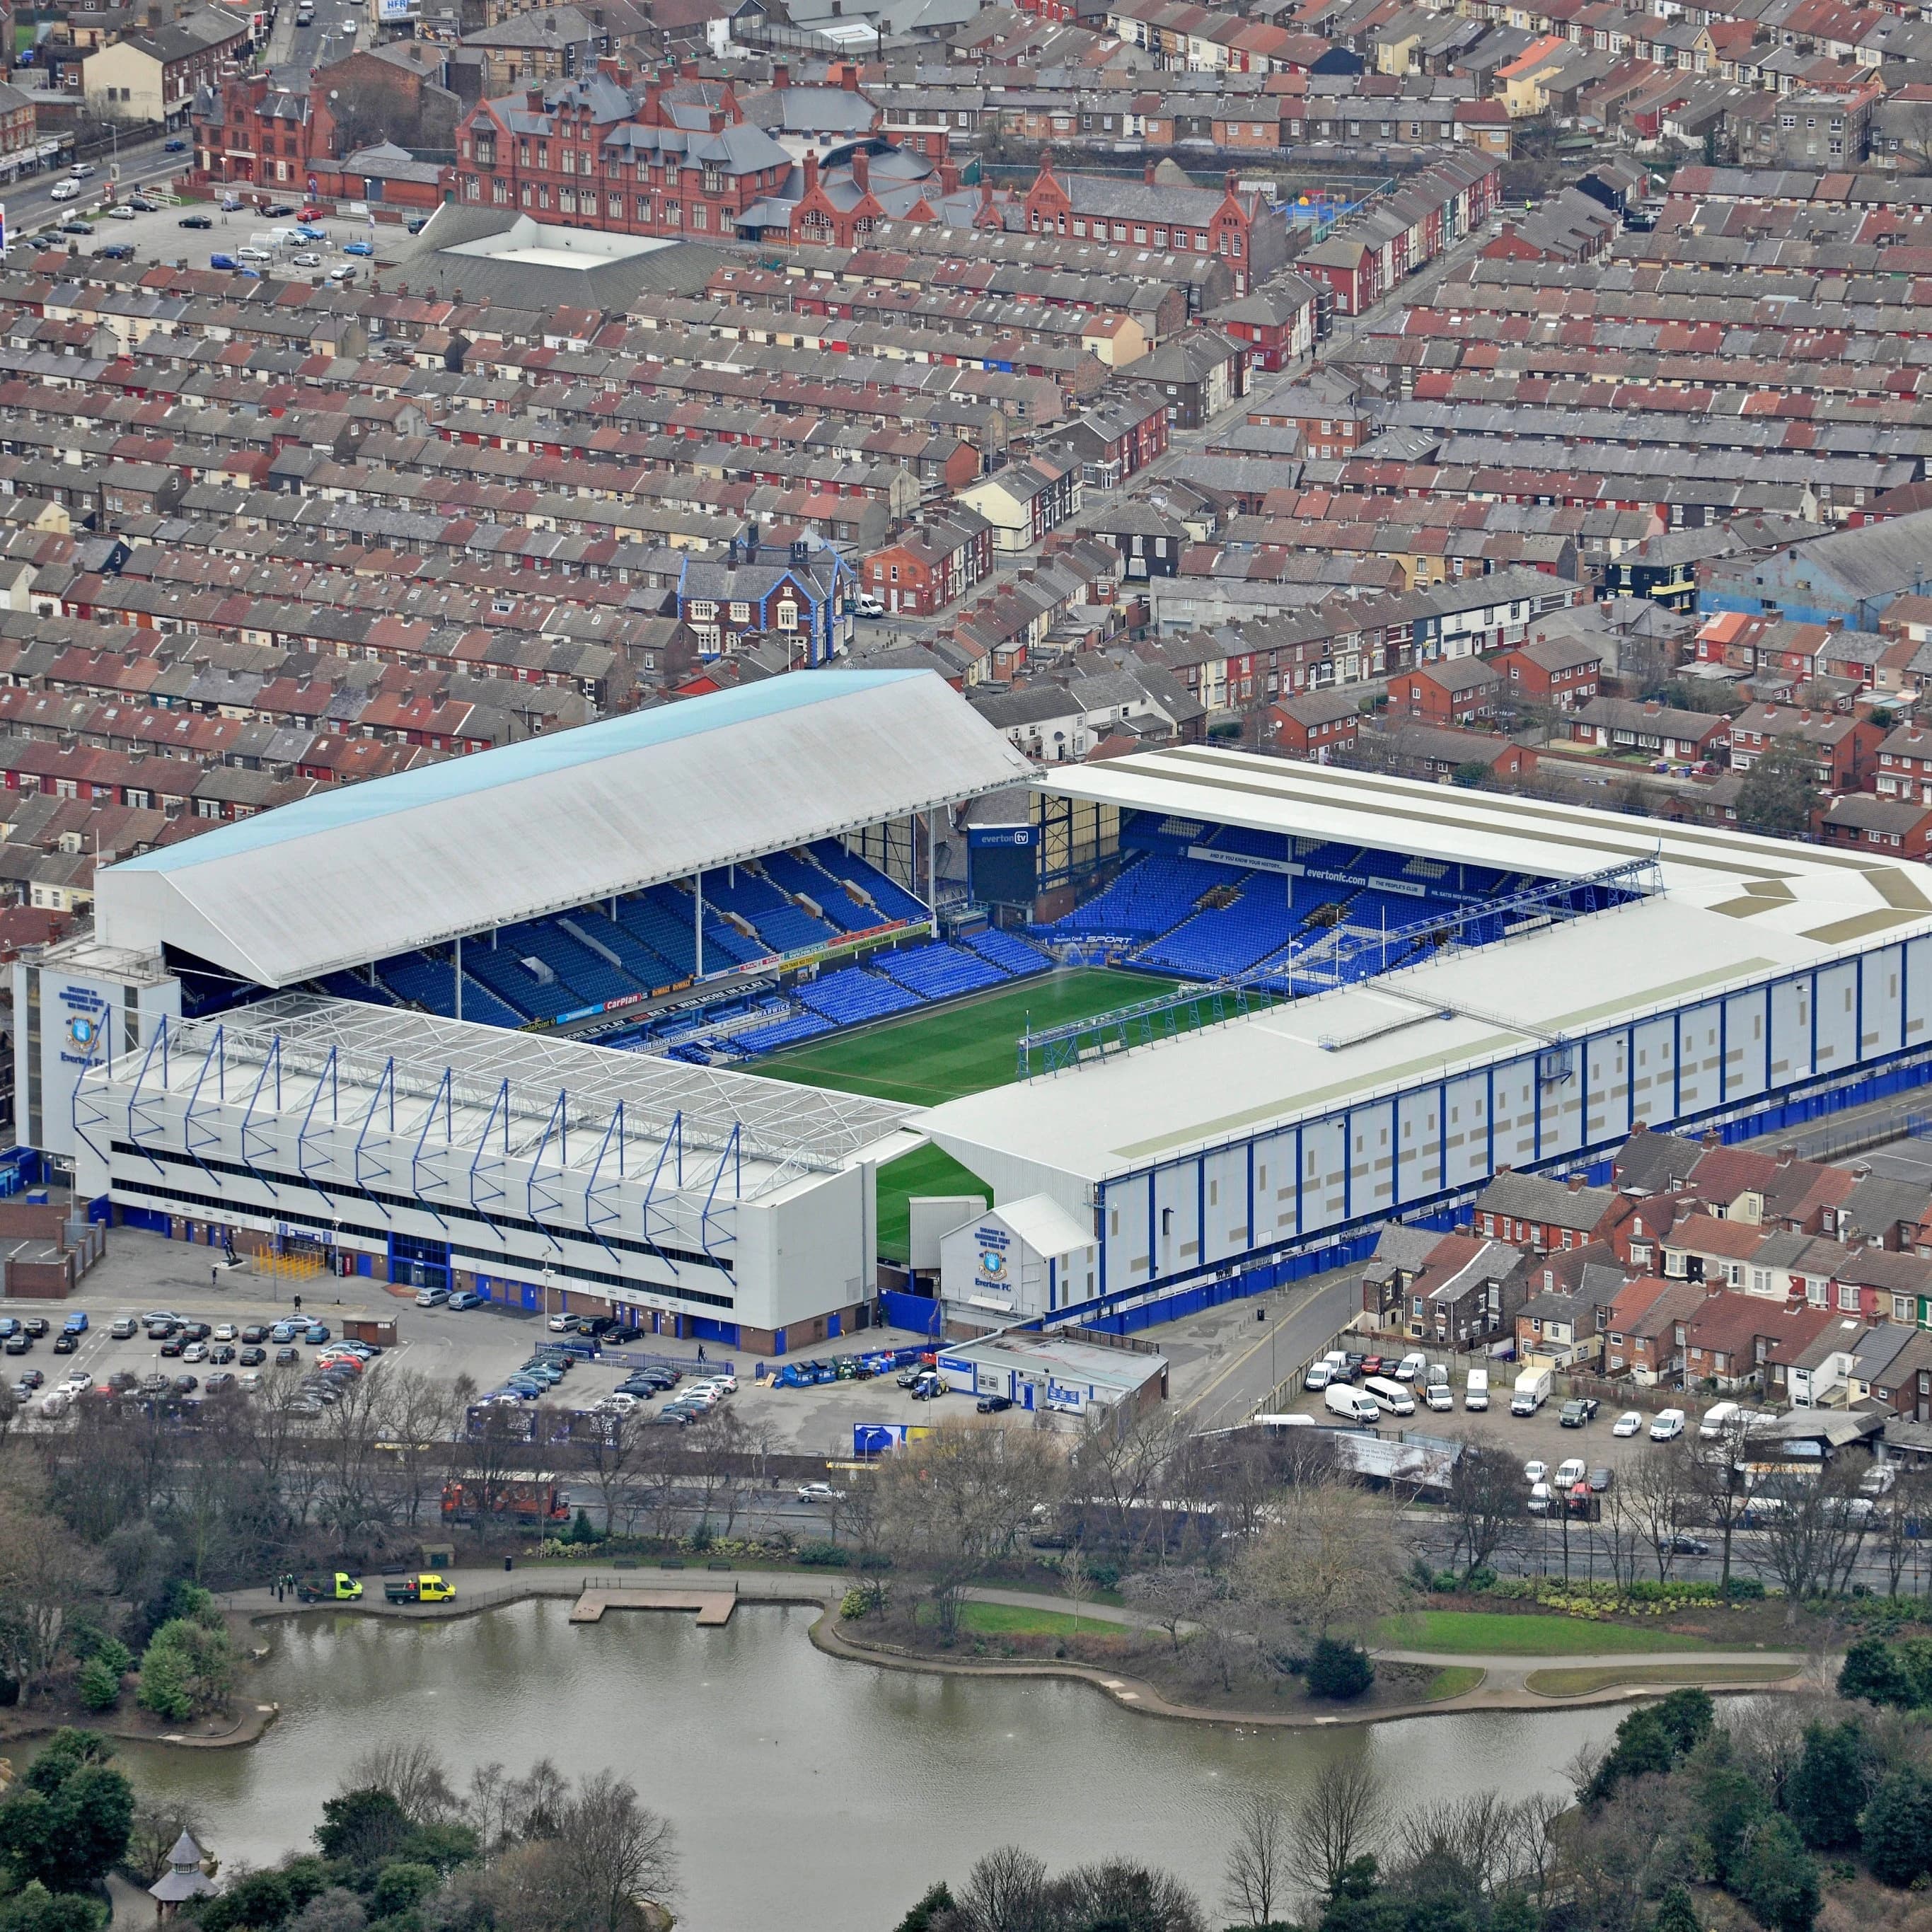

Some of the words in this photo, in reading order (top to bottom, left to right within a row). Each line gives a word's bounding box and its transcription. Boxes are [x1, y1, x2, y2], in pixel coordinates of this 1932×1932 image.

[981, 833, 1014, 843] everton
[1017, 833, 1026, 842] tv
[1307, 868, 1366, 886] evertonfc.com
[1086, 935, 1133, 944] SPORT
[607, 994, 638, 1010] CarPlan
[677, 999, 698, 1009] WIN
[698, 990, 725, 1003] MORE
[756, 1003, 791, 1019] WARWICK
[670, 1034, 687, 1043] TOOLS
[975, 1278, 1000, 1290] Everton
[1001, 1283, 1012, 1292] FC
